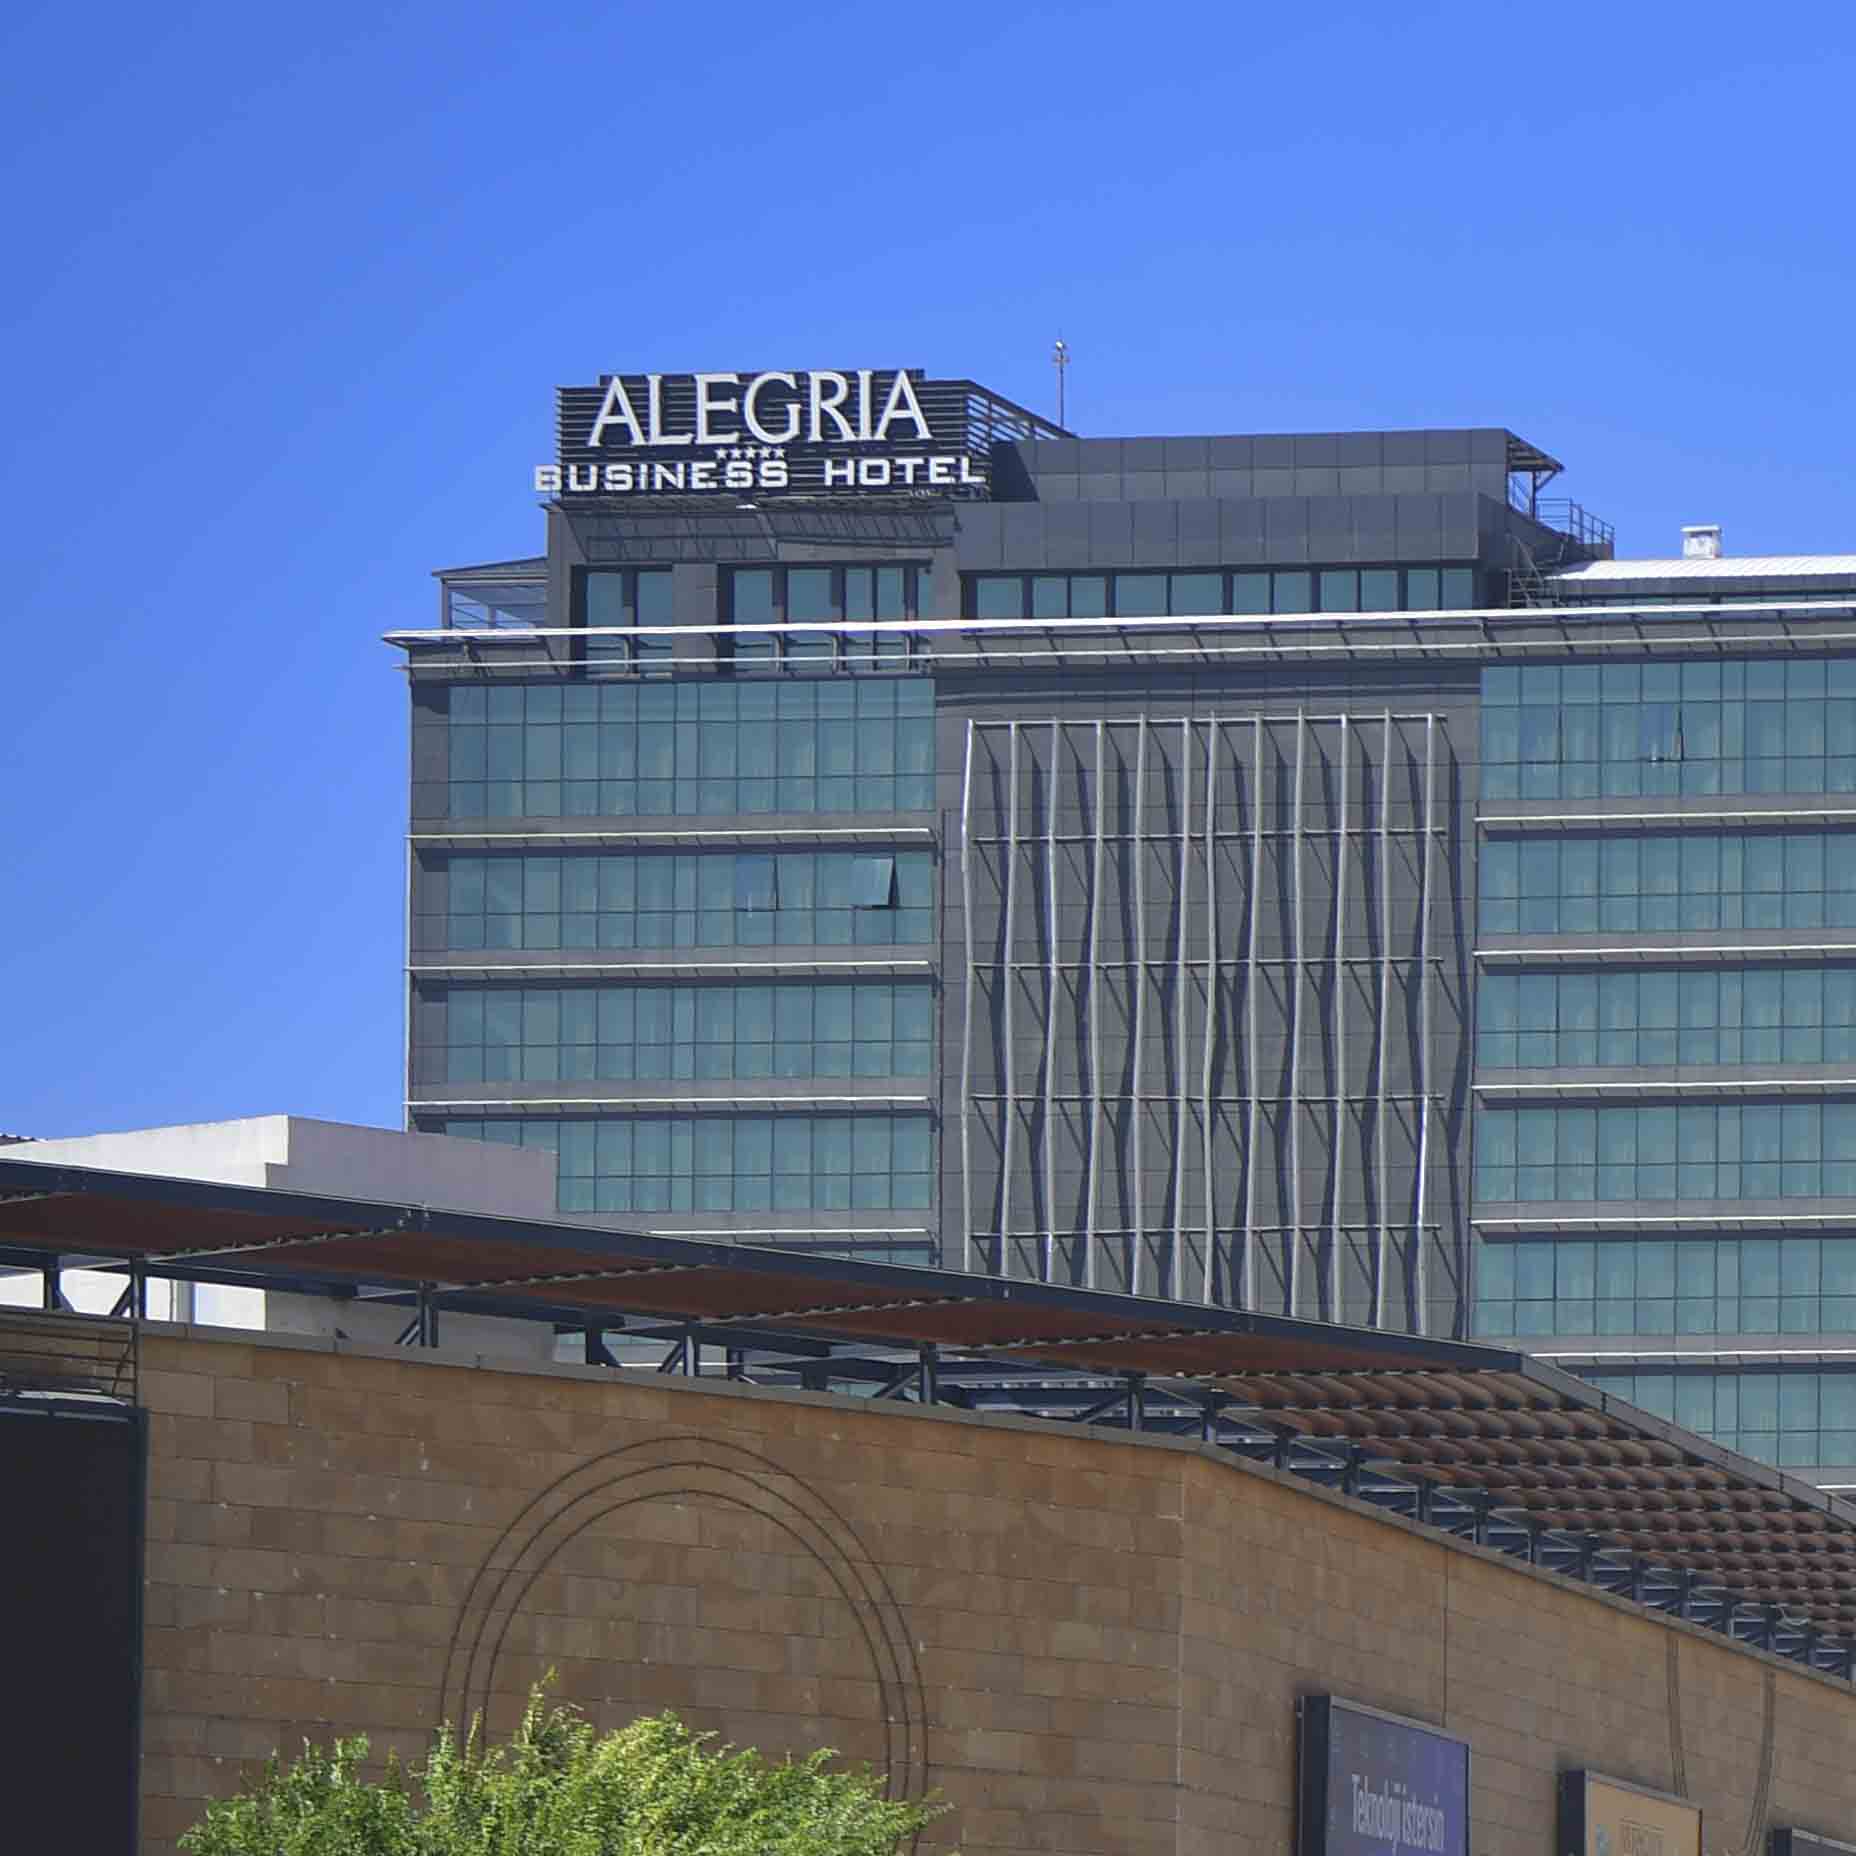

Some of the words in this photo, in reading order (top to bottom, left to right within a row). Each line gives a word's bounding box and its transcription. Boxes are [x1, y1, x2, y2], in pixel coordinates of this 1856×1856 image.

[587, 369, 932, 447] ALEGRIA
[534, 461, 788, 492] BUSINESS
[824, 456, 985, 486] HOTEL
